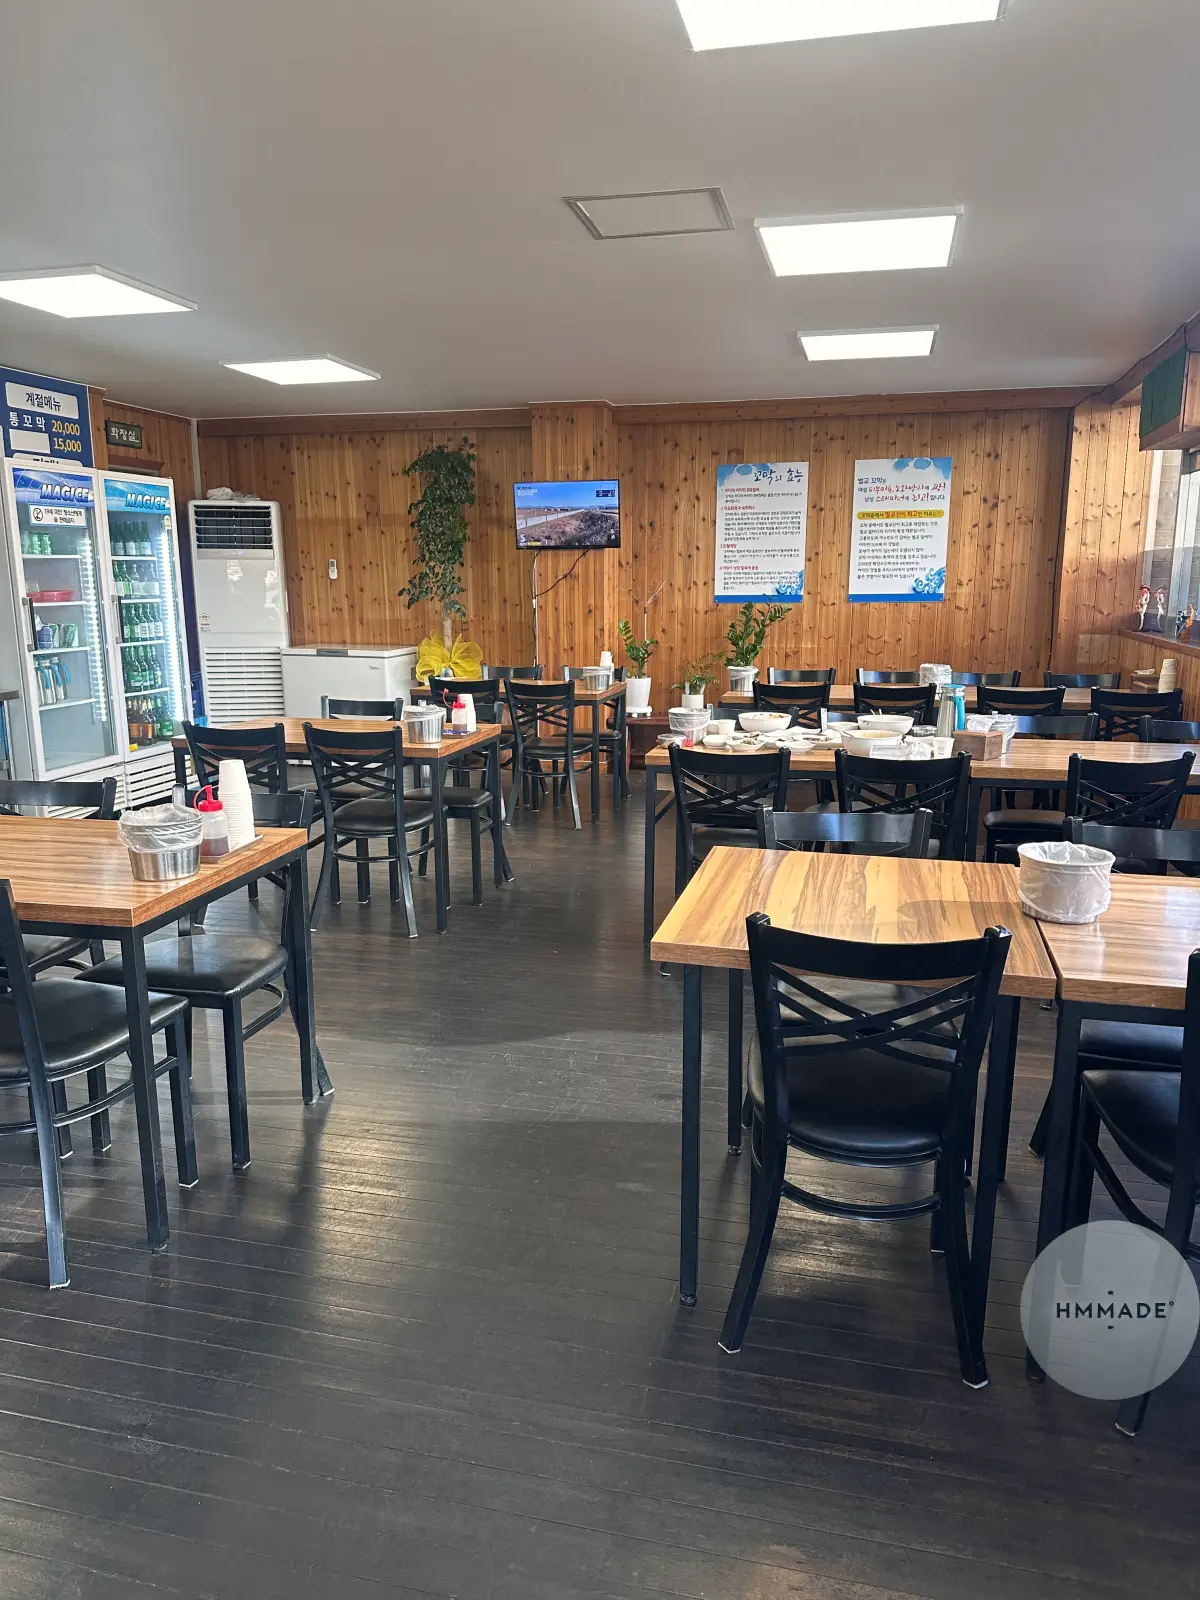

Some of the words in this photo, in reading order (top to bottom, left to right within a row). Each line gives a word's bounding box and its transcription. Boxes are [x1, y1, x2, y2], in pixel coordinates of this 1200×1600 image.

[25, 392, 61, 412] 계절메뉴
[52, 420, 80, 436] 20,000
[111, 427, 138, 441] 화장실
[54, 438, 82, 453] 15,000
[754, 469, 782, 485] 꼬막의
[787, 468, 803, 482] 효능
[40, 484, 89, 503] MAGICE
[125, 493, 166, 510] MAGICE
